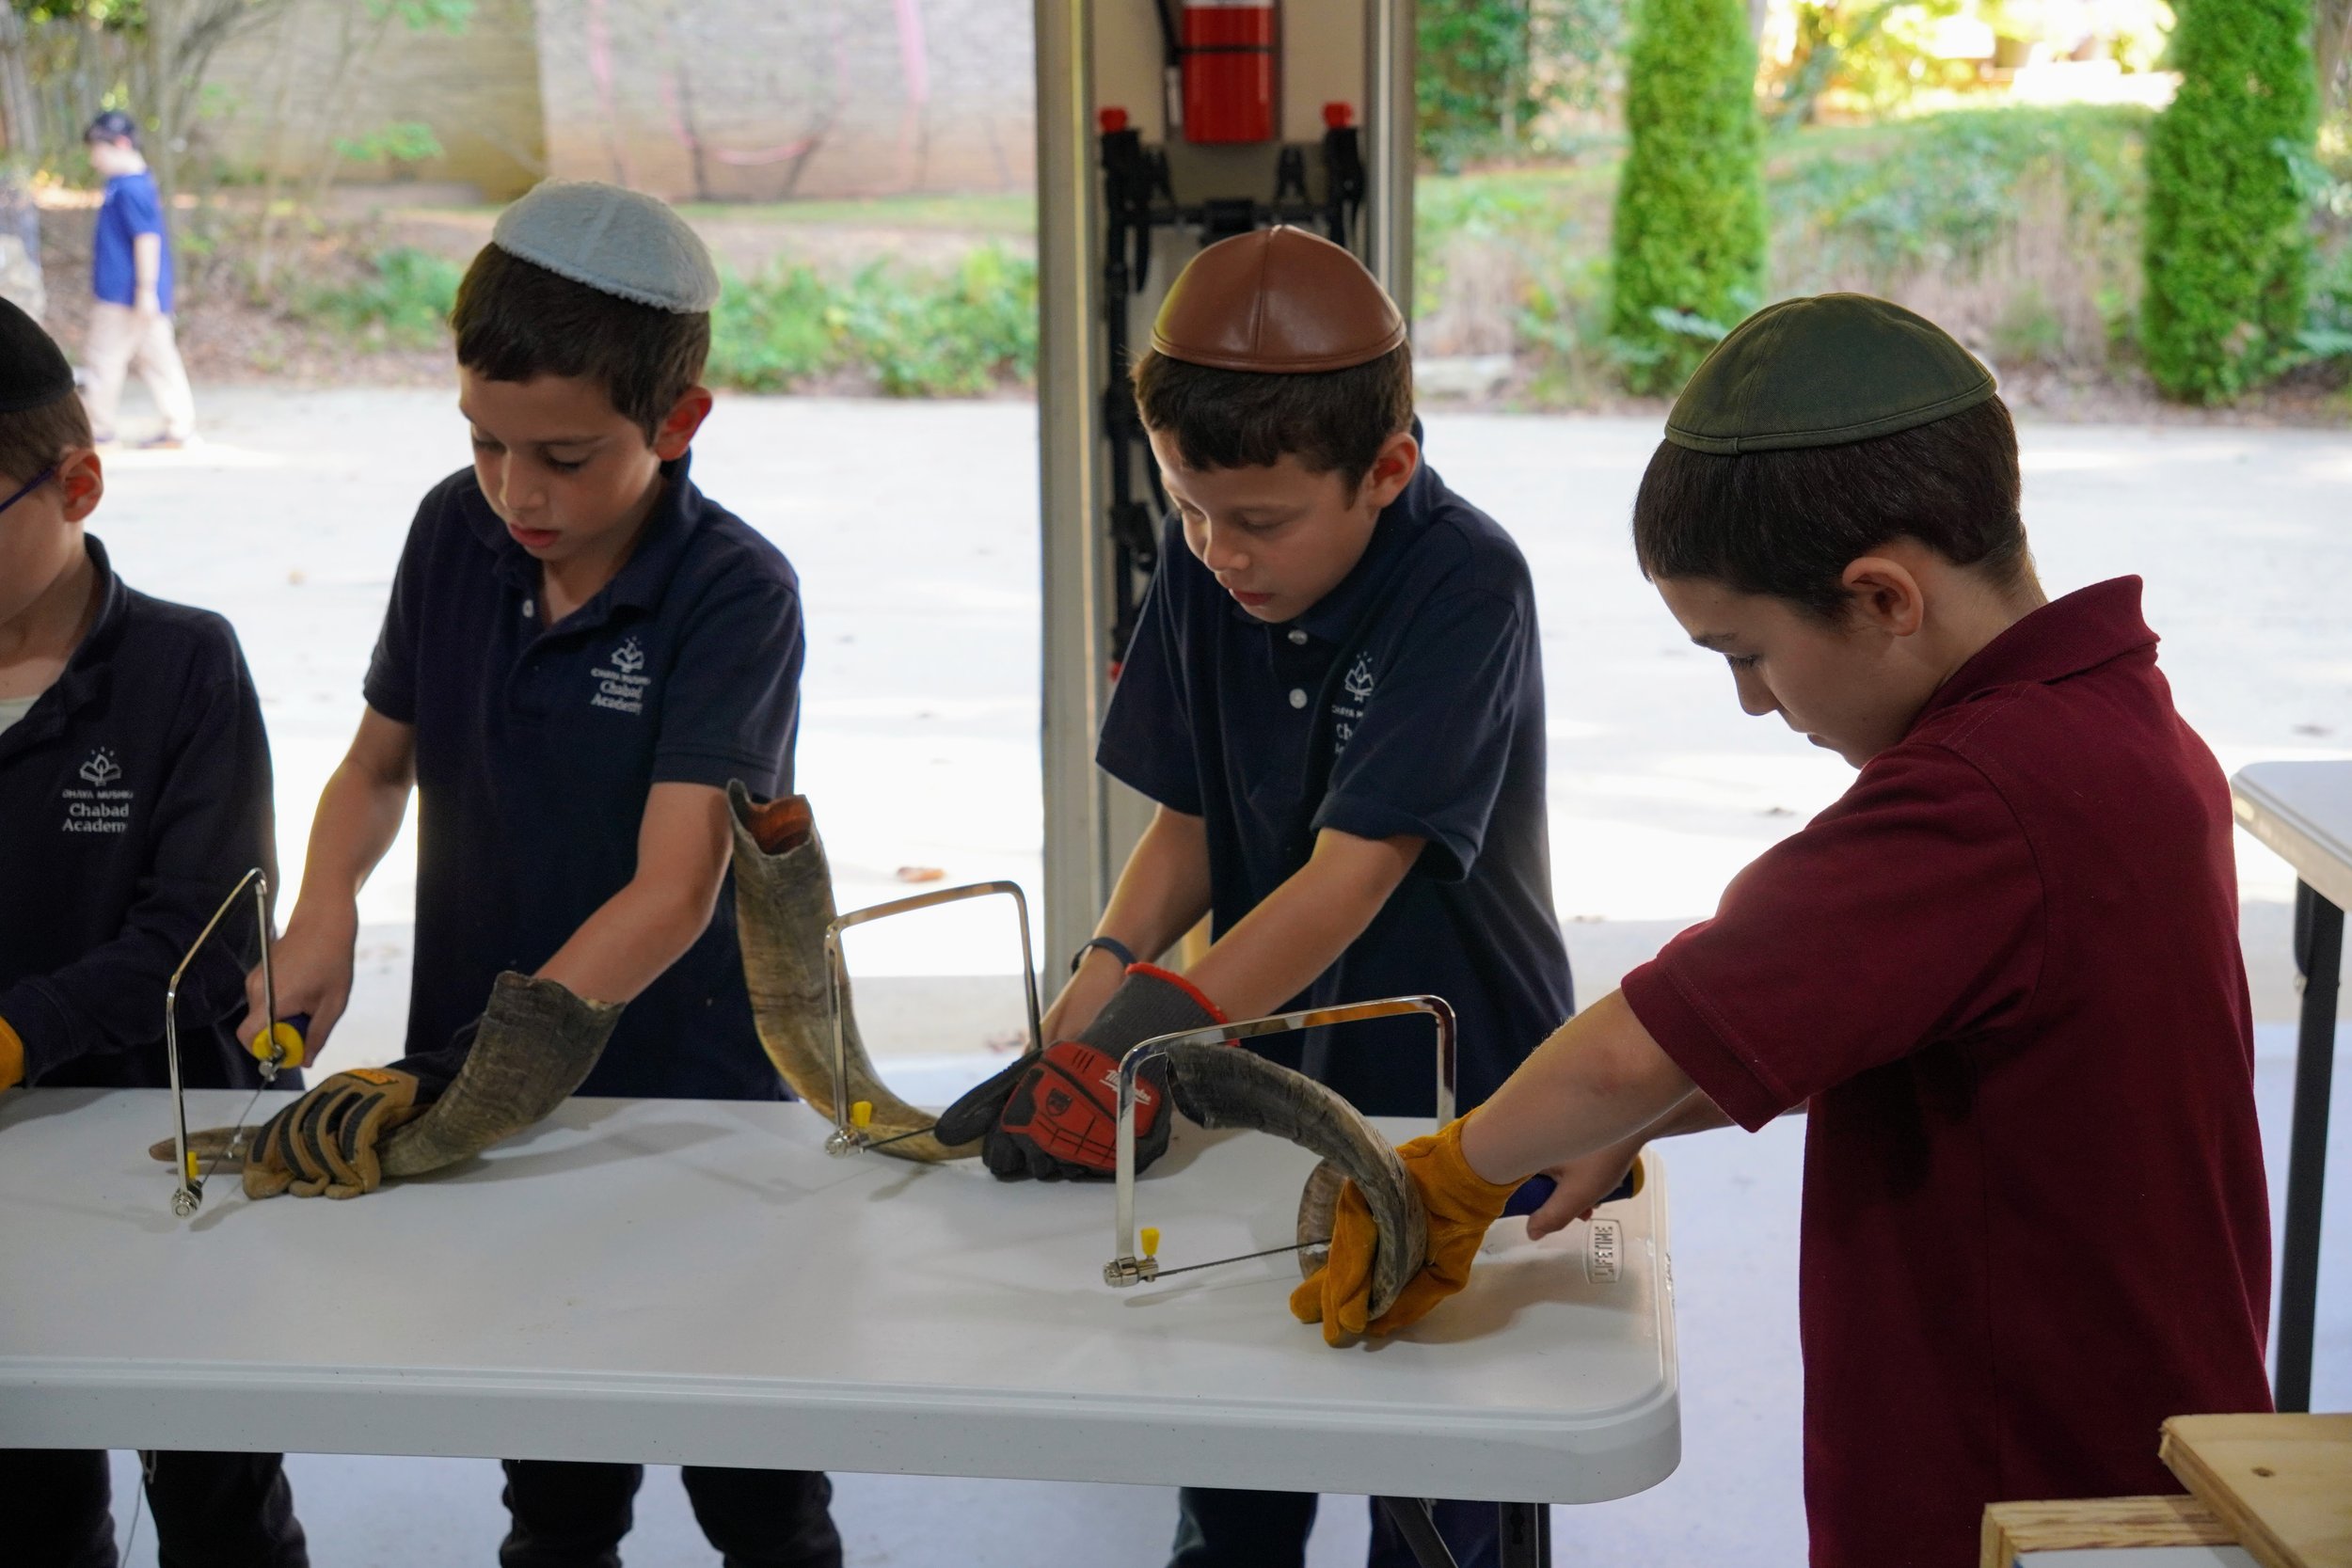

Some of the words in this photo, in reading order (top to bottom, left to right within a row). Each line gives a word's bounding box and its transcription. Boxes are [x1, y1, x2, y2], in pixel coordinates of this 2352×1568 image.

[69, 802, 130, 817] Chabad
[62, 817, 127, 832] Academ
[1594, 1226, 1615, 1276] LIFETIME
